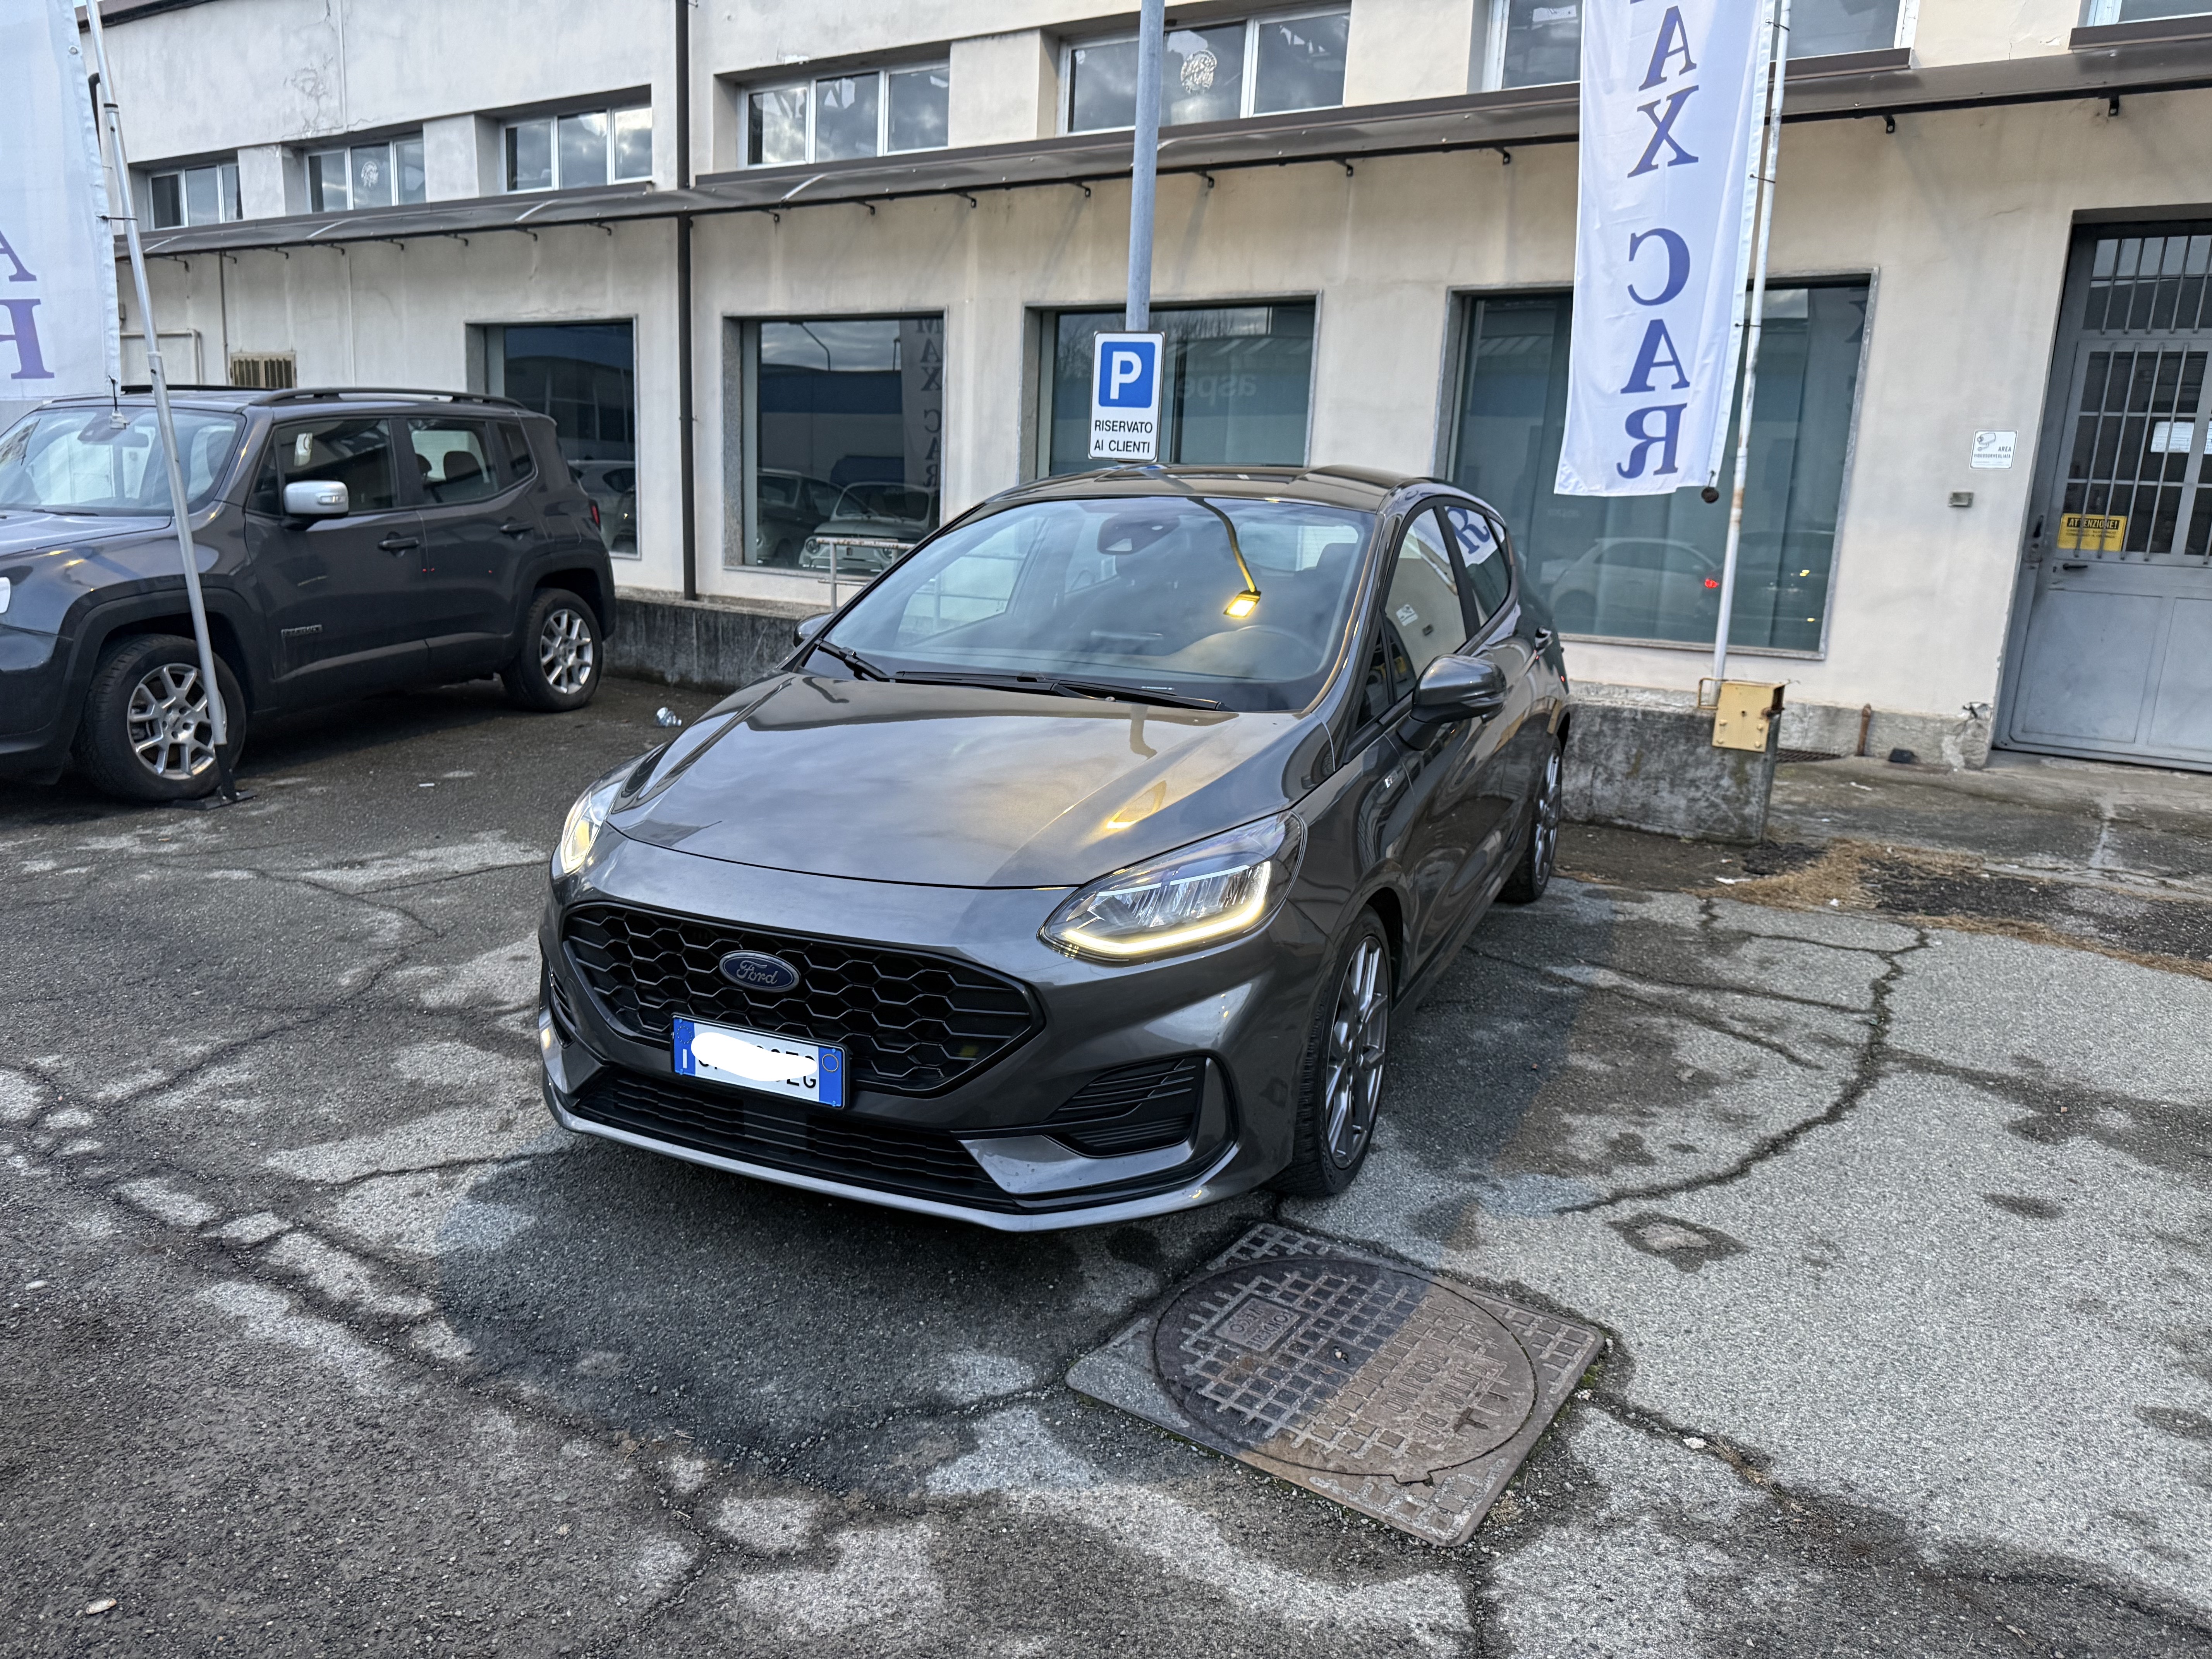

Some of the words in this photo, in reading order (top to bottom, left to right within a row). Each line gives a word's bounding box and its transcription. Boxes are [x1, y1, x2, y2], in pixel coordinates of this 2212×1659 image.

[1110, 351, 1142, 400] P
[1095, 420, 1153, 433] RISERVATO
[1094, 440, 1103, 451] AI
[1109, 440, 1150, 453] CLIENTI
[2069, 518, 2117, 529] ATENZIOE!
[736, 960, 778, 984] Ford
[1243, 1310, 1297, 1350] FONDERIE
[1379, 1354, 1451, 1414] TORINO
[1411, 1411, 1449, 1436] DI
